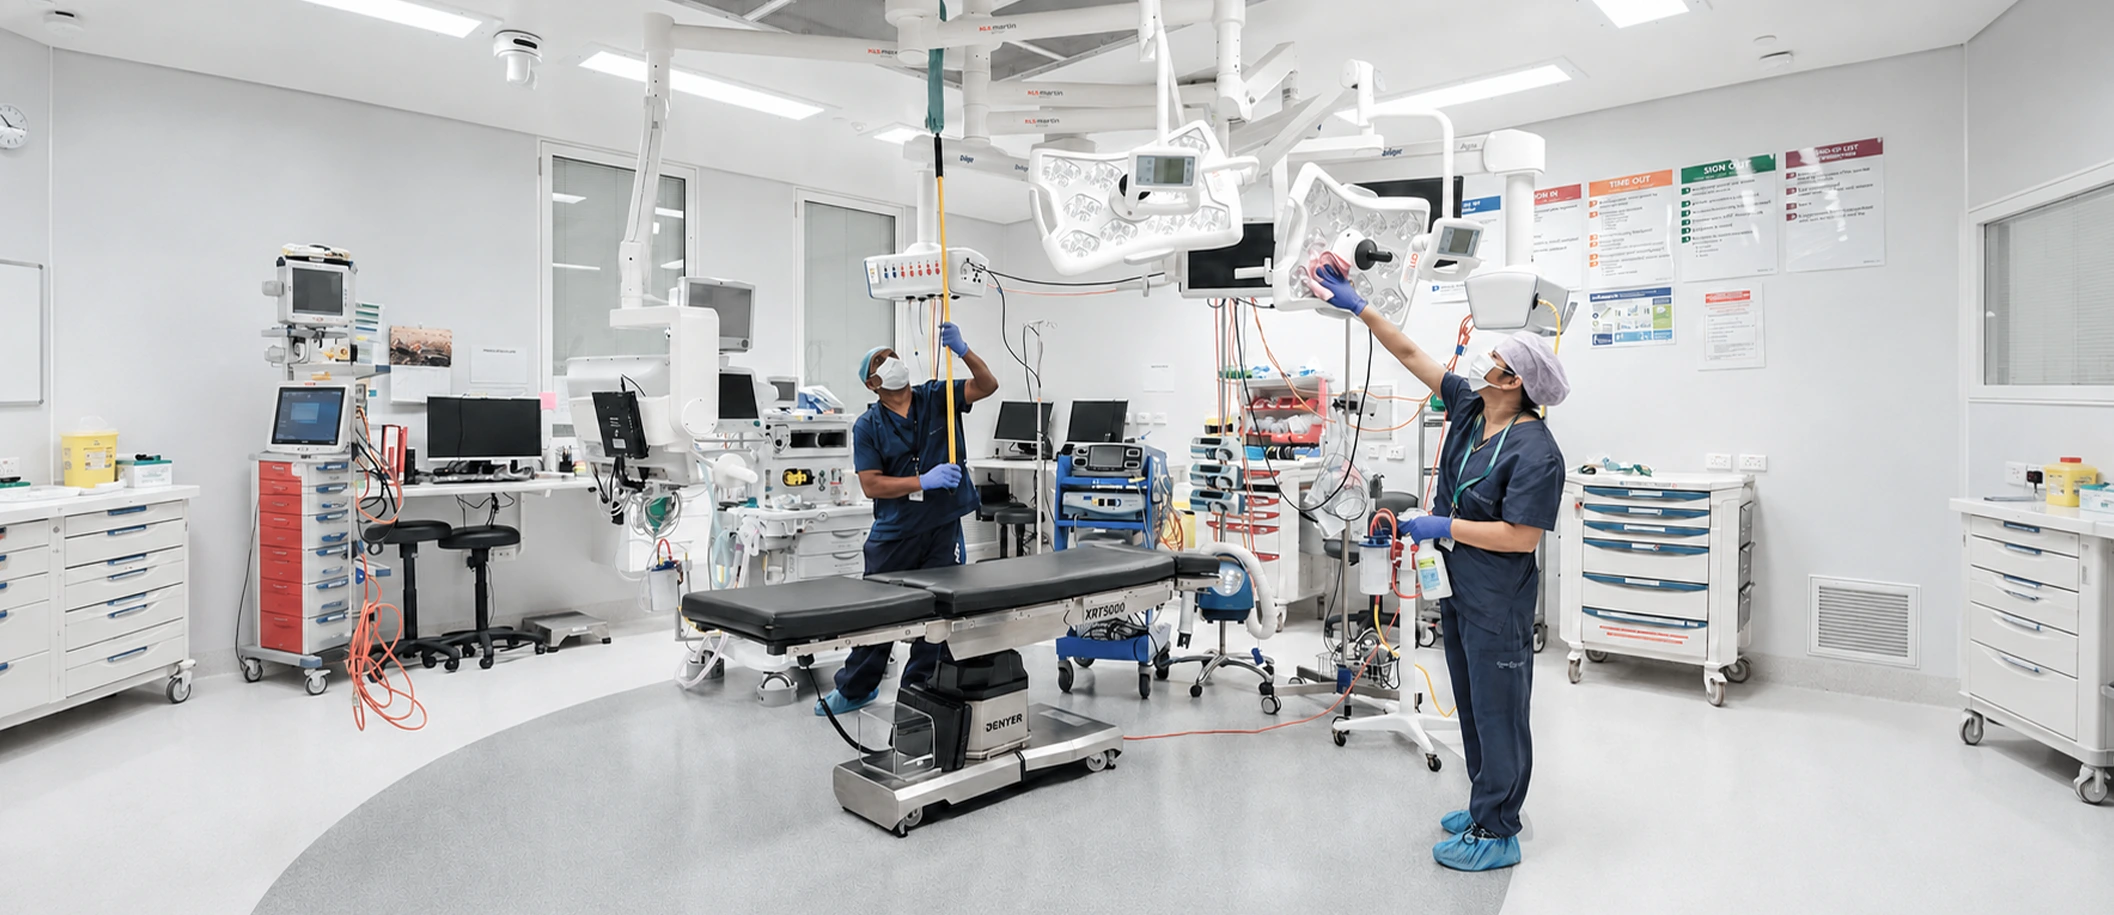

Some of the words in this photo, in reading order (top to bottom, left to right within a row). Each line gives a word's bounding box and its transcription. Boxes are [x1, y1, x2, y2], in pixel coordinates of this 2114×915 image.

[992, 23, 1017, 31] martin
[1703, 162, 1726, 175] SIGN
[1728, 159, 1752, 170] OUT
[1609, 177, 1631, 189] TIME
[1632, 174, 1652, 185] OUT
[1085, 601, 1126, 620] XRT5000
[985, 713, 1023, 733] DENYER
